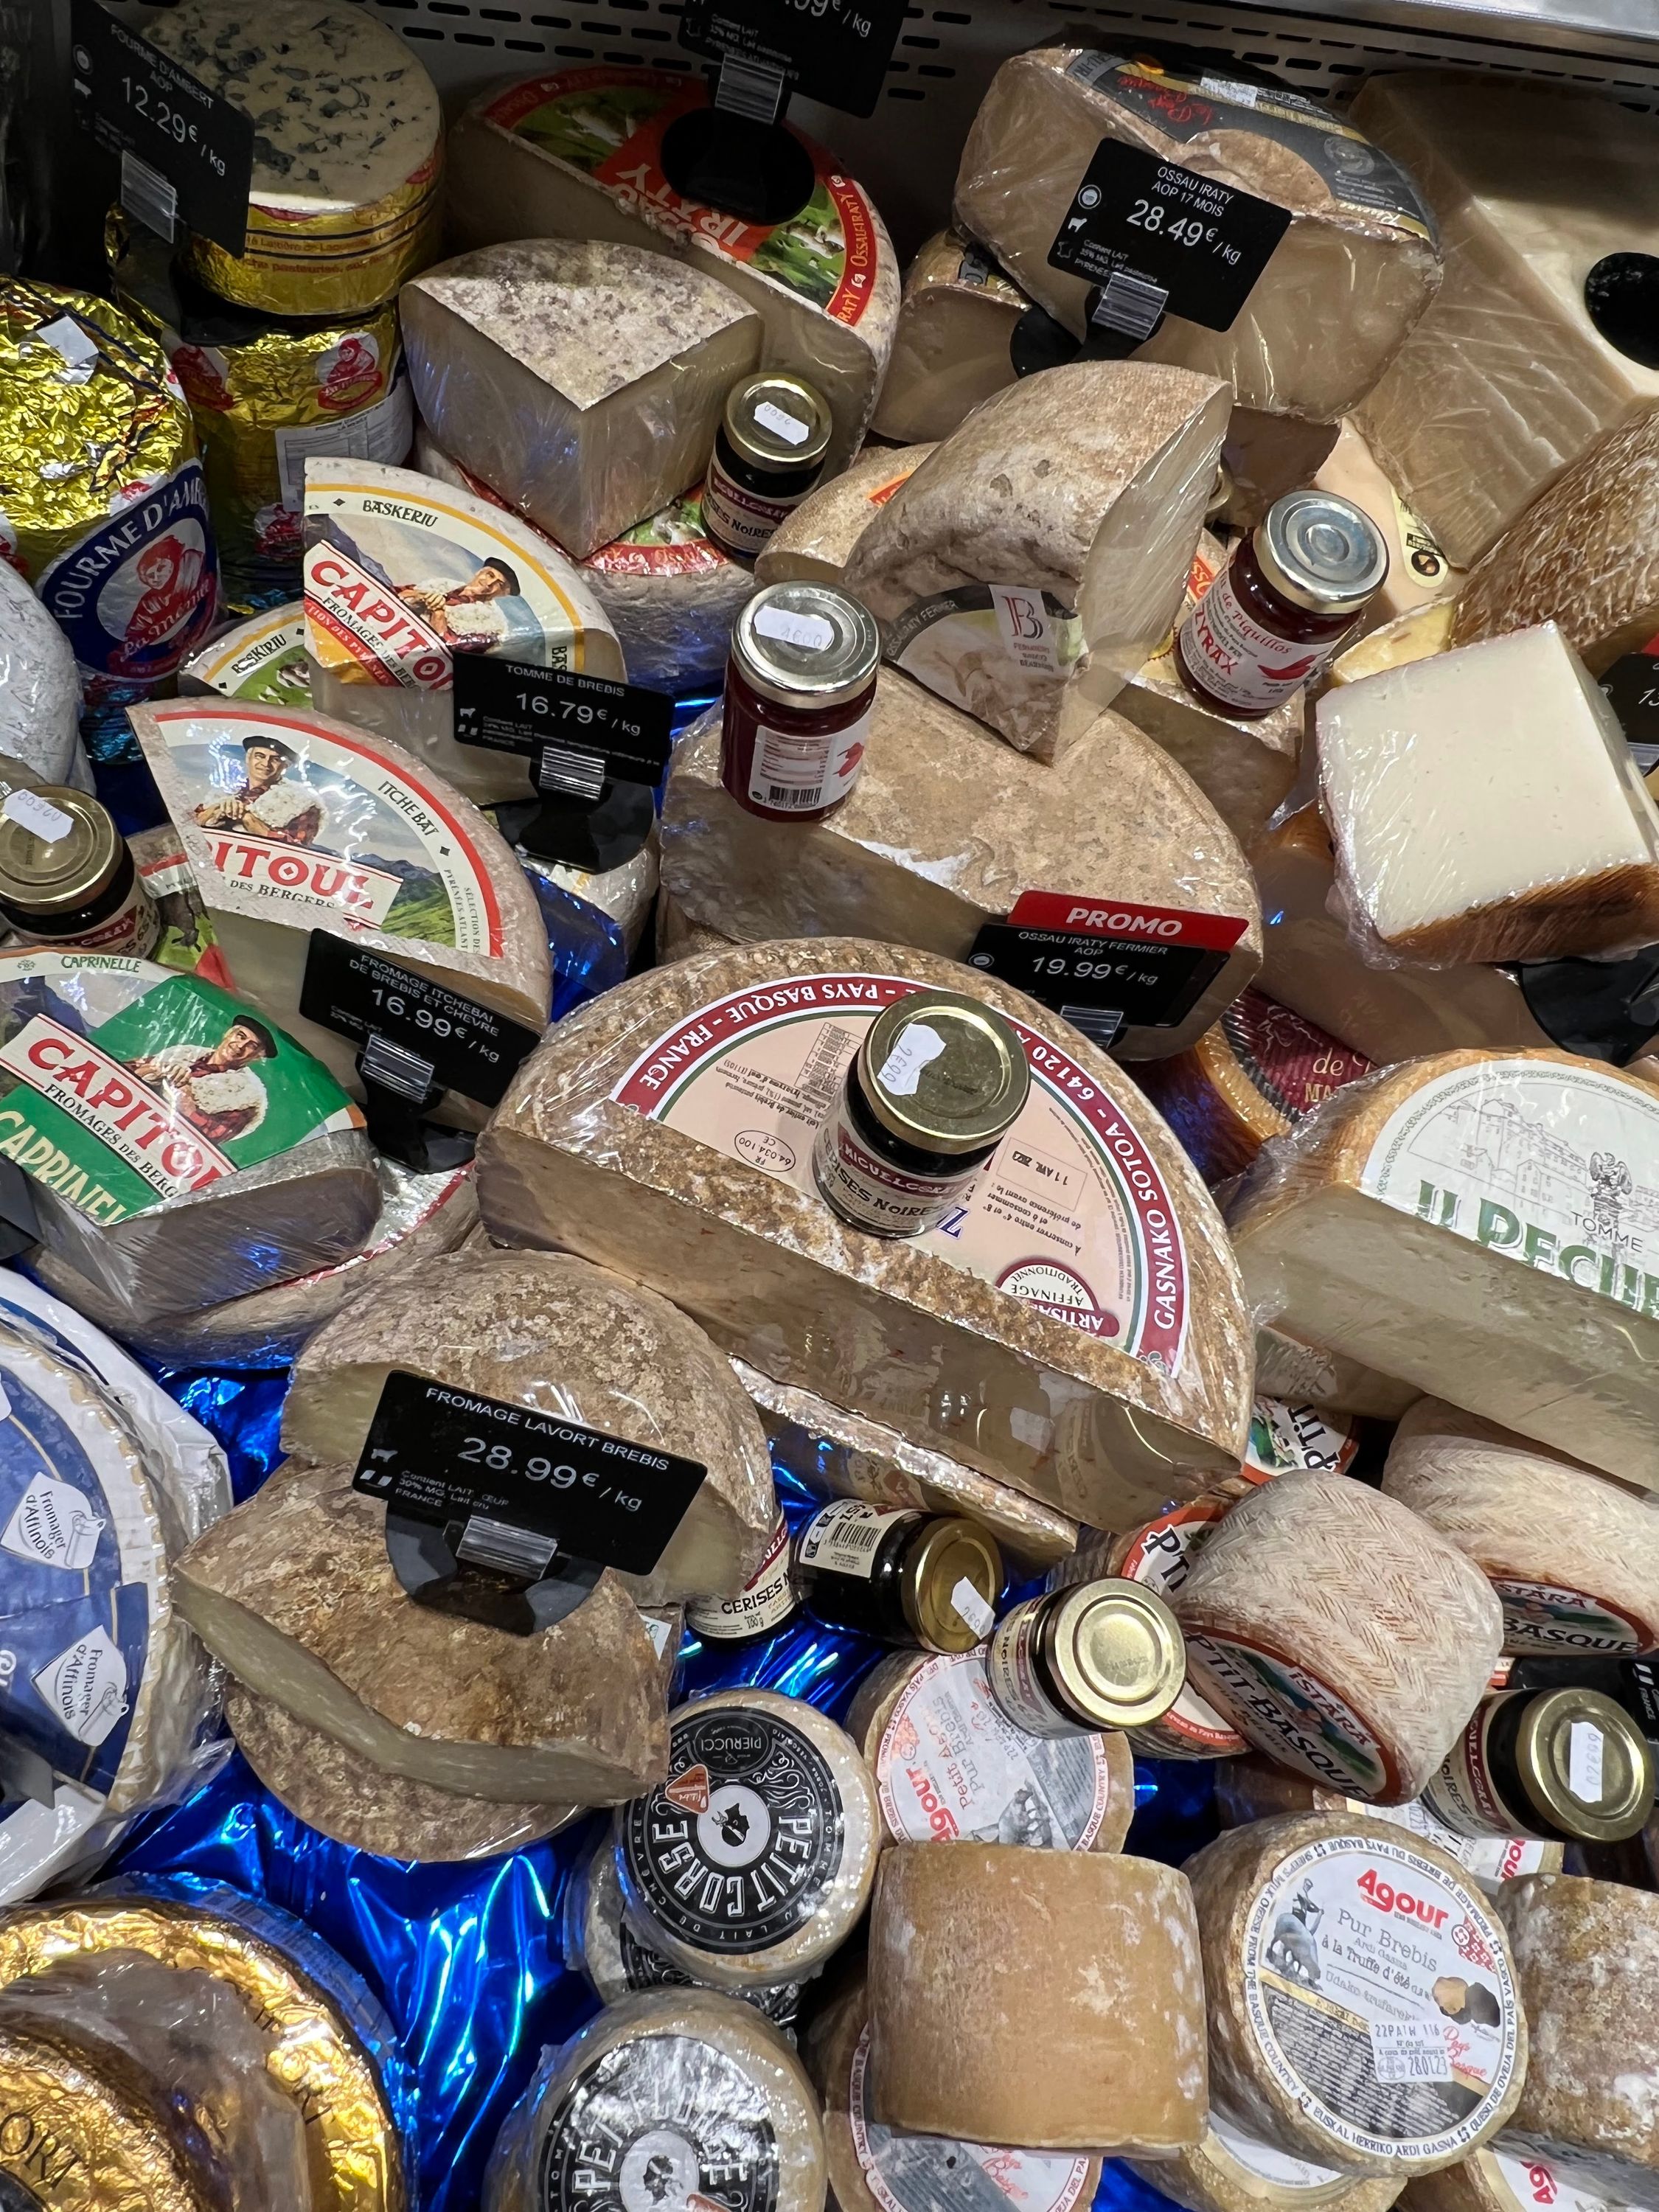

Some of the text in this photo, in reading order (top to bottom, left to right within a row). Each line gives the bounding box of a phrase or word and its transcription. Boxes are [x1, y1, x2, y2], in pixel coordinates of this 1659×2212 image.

[112, 24, 214, 109] FOURME D'AMBERT
[150, 70, 173, 92] AOP
[1151, 181, 1225, 218] AOP 17 MOIS
[1158, 166, 1236, 205] OSSAU IRATY
[362, 499, 439, 529] BASKERIU
[54, 521, 142, 619] FOURME
[322, 596, 384, 651] FROMAGES
[1222, 592, 1293, 655] de Piquillos
[505, 664, 626, 698] TOMME DE BREBIS
[230, 879, 254, 894] DES
[1065, 907, 1183, 937] PROMO
[1018, 931, 1169, 956] OSSAU IRATY FERMIER
[1073, 946, 1105, 957] AOP
[60, 954, 142, 975] CAPRINELLE
[349, 959, 500, 1037] DE BREBIS ET CHEVRE
[361, 953, 494, 1024] FROMAGE ITCHEBAI
[639, 982, 879, 1092] PAYS BASQUE FRANCE
[1032, 1044, 1096, 1101] 64120
[1312, 1046, 1344, 1077] de
[44, 1082, 122, 1151] FROMAGES
[117, 1141, 142, 1165] DES
[762, 1135, 777, 1147] CE
[738, 1135, 792, 1167] 64.034.100
[754, 1155, 768, 1166] FR
[1104, 1124, 1160, 1203] SOTOA
[987, 1192, 1032, 1217] consommer
[1005, 1189, 1028, 1204] avant
[1014, 1216, 1035, 1231] entre
[1036, 1227, 1074, 1248] conserver
[1570, 1211, 1645, 1253] TOMME
[1010, 1265, 1085, 1295] TRADITIONNEL
[1149, 1209, 1178, 1329] GASNAKO
[1010, 1283, 1084, 1307] AFFINAGE
[425, 1387, 670, 1472] FROMAGE LAVORT BREBIS
[394, 1487, 443, 1507] FRANCE
[447, 1480, 475, 1495] LAIT
[40, 1490, 66, 1550] Fromager
[720, 1582, 784, 1615] CERISES
[80, 1648, 104, 1717] Fromager
[700, 1736, 762, 1752] PIERUCCI
[933, 1697, 986, 1796] Pur Brebis
[1253, 1691, 1377, 1800] BASQUE
[946, 1760, 973, 1811] Petit
[651, 1819, 746, 1917] CORSE
[750, 1815, 813, 1913] PETIT
[1357, 1868, 1450, 1931] Agour
[1332, 1938, 1343, 1955] la
[1346, 1945, 1381, 1975] Truffe
[1337, 1907, 1438, 1973] Pur Brebis
[1497, 1958, 1514, 1996] VASCO
[1505, 2028, 1515, 2050] DEL
[1264, 2040, 1299, 2093] COUNTRY
[1489, 2086, 1502, 2105] DE
[1313, 2106, 1458, 2157] EUSKAL HERRIKO ARDI GASNA
[1470, 2101, 1493, 2132] QUESO
